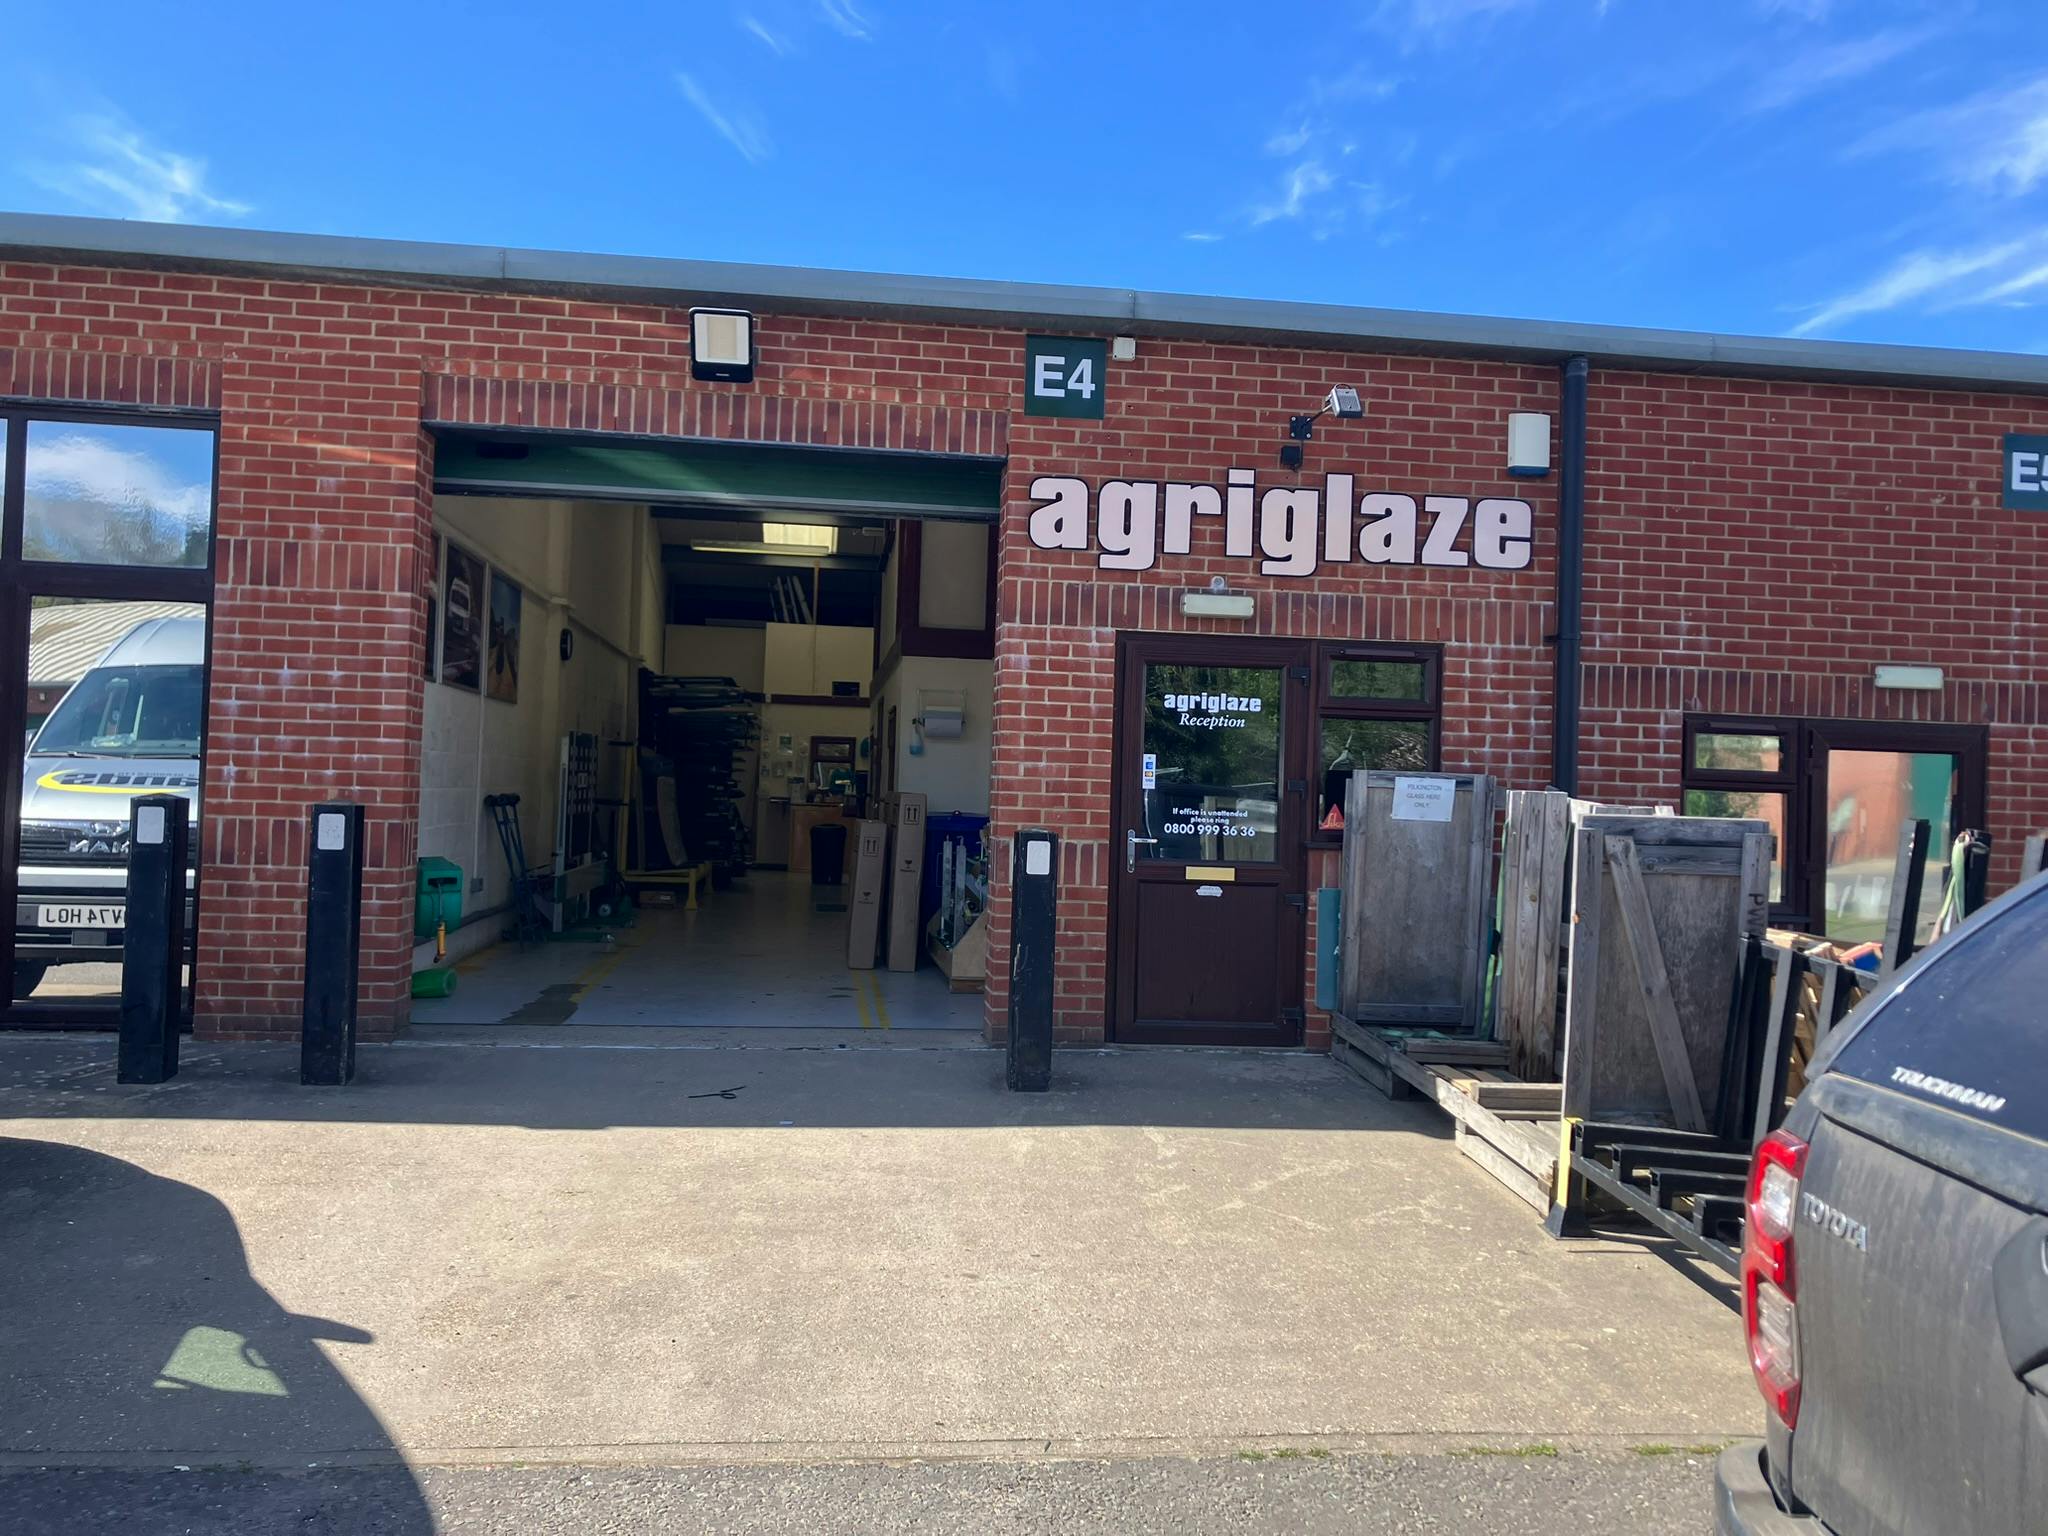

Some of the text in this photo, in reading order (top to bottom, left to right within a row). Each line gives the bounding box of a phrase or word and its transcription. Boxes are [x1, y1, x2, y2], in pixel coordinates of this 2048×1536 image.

[1034, 354, 1096, 399] E4
[2011, 452, 2048, 492] E
[1028, 467, 1533, 577] agriglaze
[1164, 692, 1261, 713] agriglaze
[1179, 713, 1246, 730] Reception
[1172, 807, 1178, 815] If
[1179, 808, 1199, 816] office
[1207, 810, 1248, 818] unattended
[1190, 816, 1230, 825] please ring
[1164, 823, 1256, 837] 0800 999 36 36
[1891, 1066, 2006, 1112] TRUCKMAN
[1803, 1192, 1868, 1251] TOYOTA
